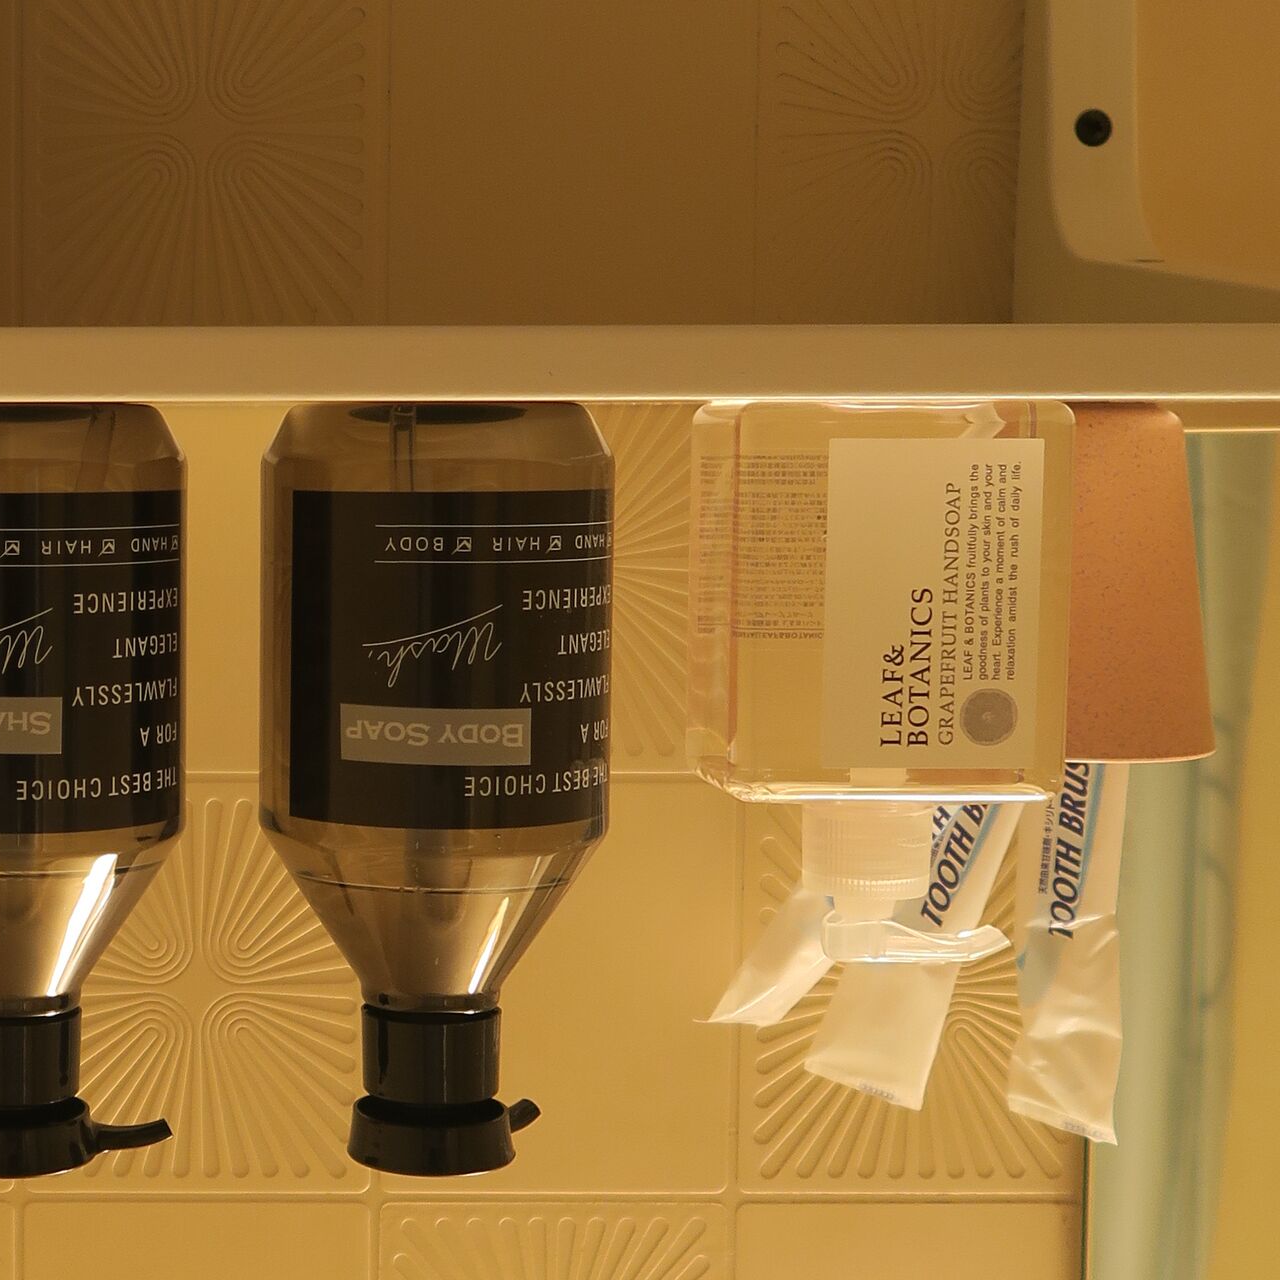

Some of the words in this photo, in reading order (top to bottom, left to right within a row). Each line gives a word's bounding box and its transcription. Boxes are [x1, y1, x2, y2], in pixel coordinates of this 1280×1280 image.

[971, 464, 979, 480] the
[985, 464, 993, 488] your
[999, 464, 1007, 483] and
[969, 486, 979, 519] brings
[984, 491, 992, 511] and
[998, 488, 1006, 511] calm
[1012, 486, 1022, 512] daily
[983, 515, 991, 534] skin
[998, 515, 1005, 526] of
[1011, 517, 1019, 529] of
[42, 540, 92, 555] HAIR
[131, 537, 167, 553] HAND
[385, 537, 443, 551] BODY
[493, 536, 540, 551] HAIR
[576, 533, 605, 549] HAND
[943, 483, 962, 605] HANDSOAP
[968, 523, 979, 568] fruitfully
[983, 537, 992, 563] your
[997, 530, 1005, 573] moment
[1010, 534, 1018, 558] rush
[983, 567, 990, 578] to
[1009, 564, 1017, 580] the
[74, 588, 177, 614] EXPERIENCE
[522, 584, 611, 610] EXPERIENCE
[968, 572, 976, 633] BOTANICS
[981, 581, 990, 612] plants
[1009, 582, 1017, 622] amidst
[982, 616, 989, 627] of
[993, 588, 1004, 647] Experience
[112, 632, 177, 658] ELEGANT
[558, 629, 610, 655] ELEGANT
[968, 638, 974, 646] &
[1006, 628, 1016, 680] relaxation
[907, 588, 933, 747] BOTANICS
[964, 649, 973, 680] LEAF
[979, 633, 989, 680] goodness
[520, 673, 609, 702] FLAWLESSLY
[938, 612, 957, 745] GRAPEFRUIT
[72, 677, 177, 706] FLAWLESSLY
[880, 644, 905, 747] LEAF&
[140, 728, 149, 747] A
[157, 721, 177, 743] FOR
[580, 723, 589, 743] A
[593, 719, 608, 741] FOR
[108, 773, 151, 796] BEST
[157, 767, 176, 789] THE
[464, 773, 546, 797] CHOICE
[552, 769, 589, 793] BEST
[592, 762, 608, 785] THE
[16, 778, 101, 801] CHOICE
[921, 820, 975, 928] TOOTH
[1049, 837, 1082, 940] TOOTH
